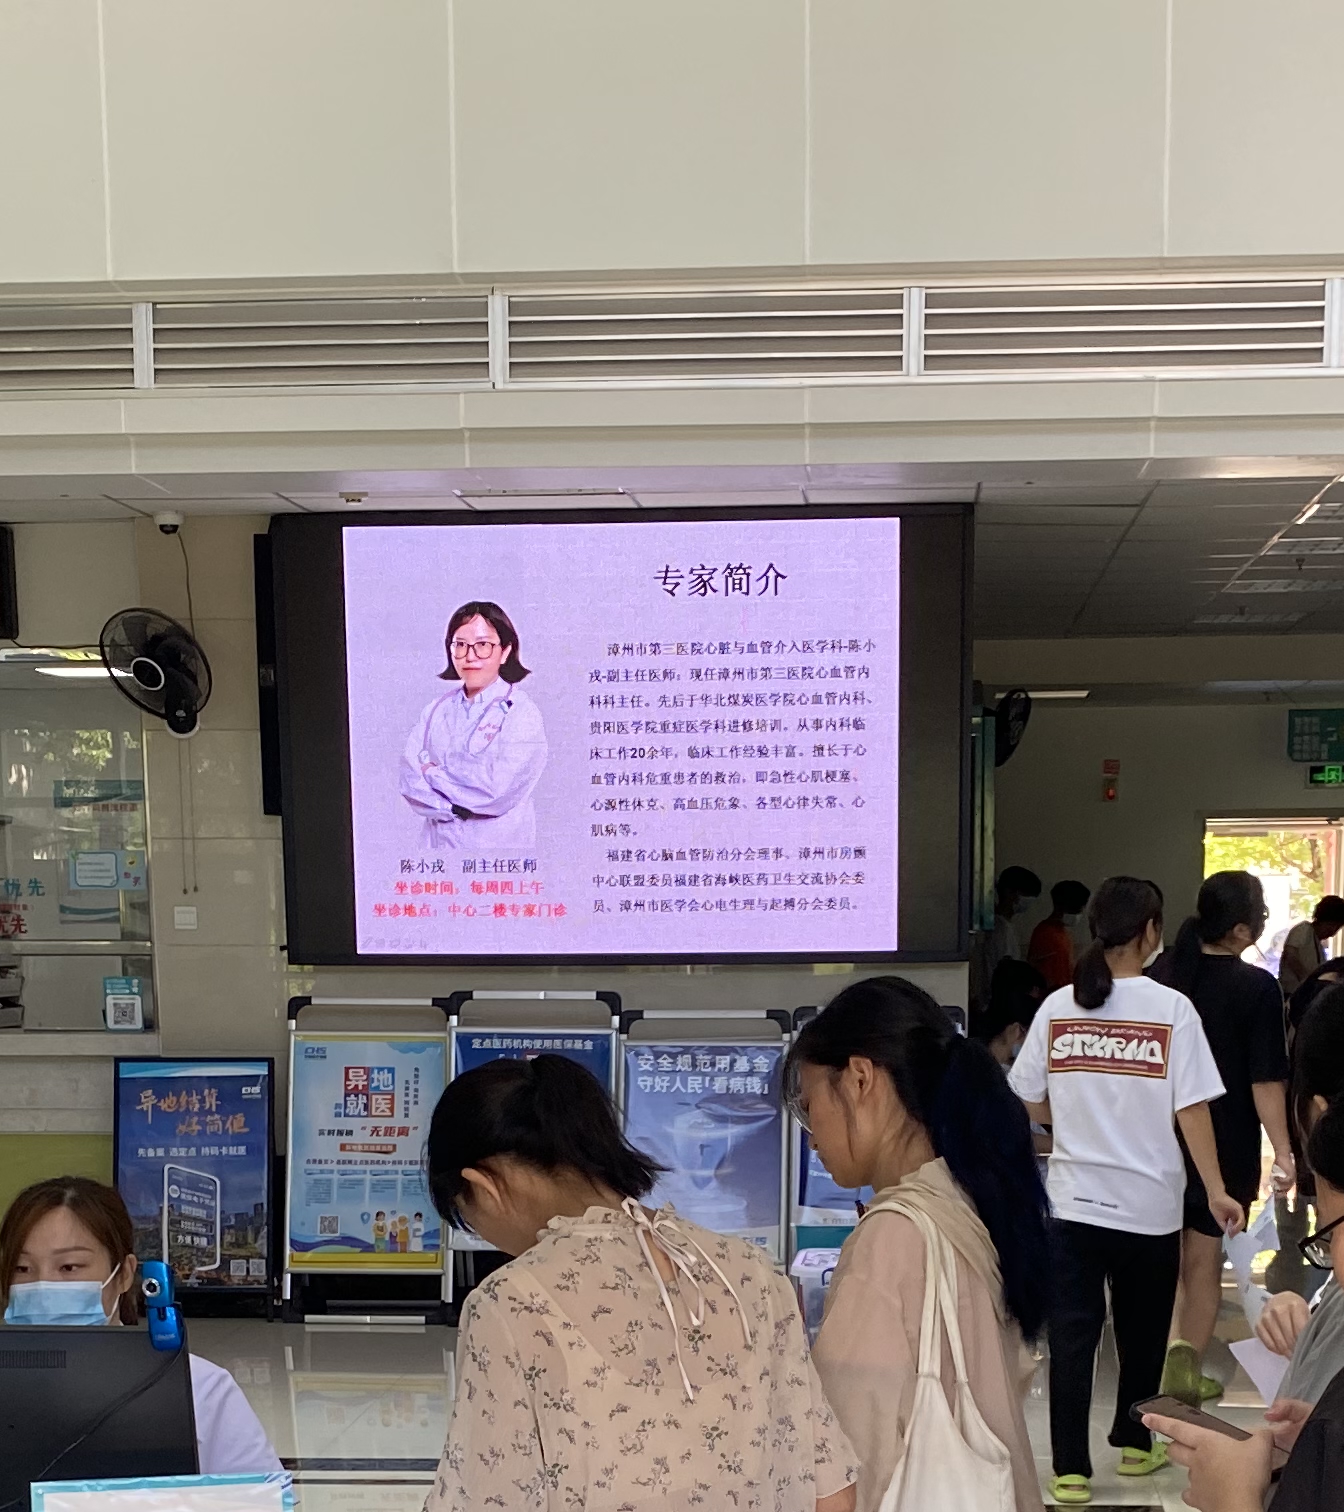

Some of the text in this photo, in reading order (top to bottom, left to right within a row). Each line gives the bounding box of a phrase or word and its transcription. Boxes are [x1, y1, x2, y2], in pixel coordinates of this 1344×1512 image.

[653, 563, 788, 599] 专家简介
[462, 858, 538, 874] 副主任医师
[637, 1054, 771, 1073] 安全规范用基金
[346, 1067, 394, 1091] 异地
[345, 1094, 393, 1117] 就医
